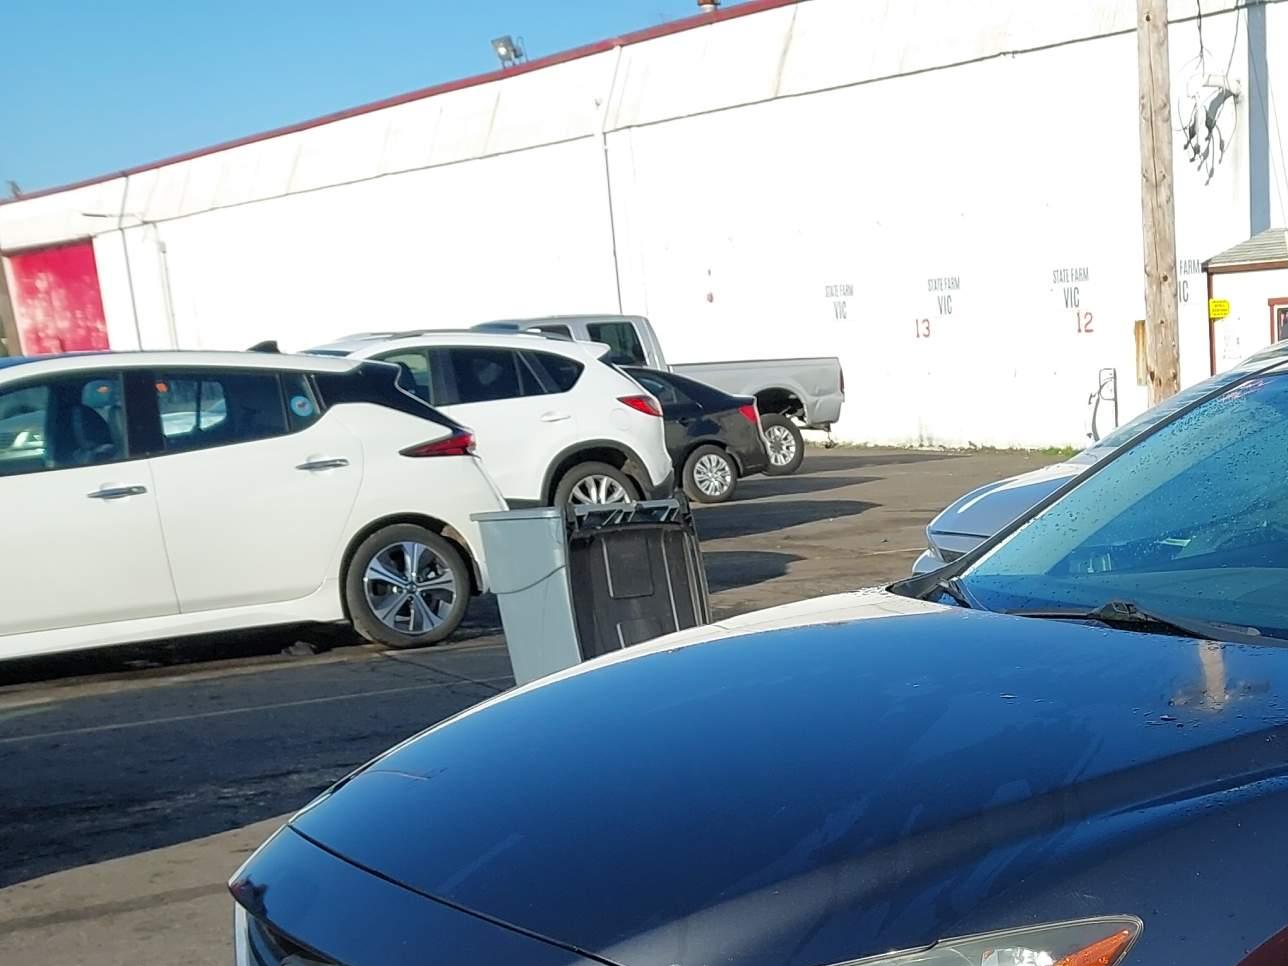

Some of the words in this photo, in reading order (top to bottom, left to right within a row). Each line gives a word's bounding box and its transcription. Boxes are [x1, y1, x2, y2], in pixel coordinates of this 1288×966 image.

[1052, 268, 1069, 284] STATE
[1070, 267, 1089, 282] FARM
[1179, 259, 1200, 275] FARM
[927, 277, 944, 292] STATE
[944, 275, 960, 290] FARM
[1178, 280, 1189, 303] IC
[937, 294, 952, 315] VIC
[1063, 286, 1080, 309] VIC
[832, 300, 847, 320] VIC
[915, 318, 930, 338] 13
[1077, 310, 1094, 333] 12
